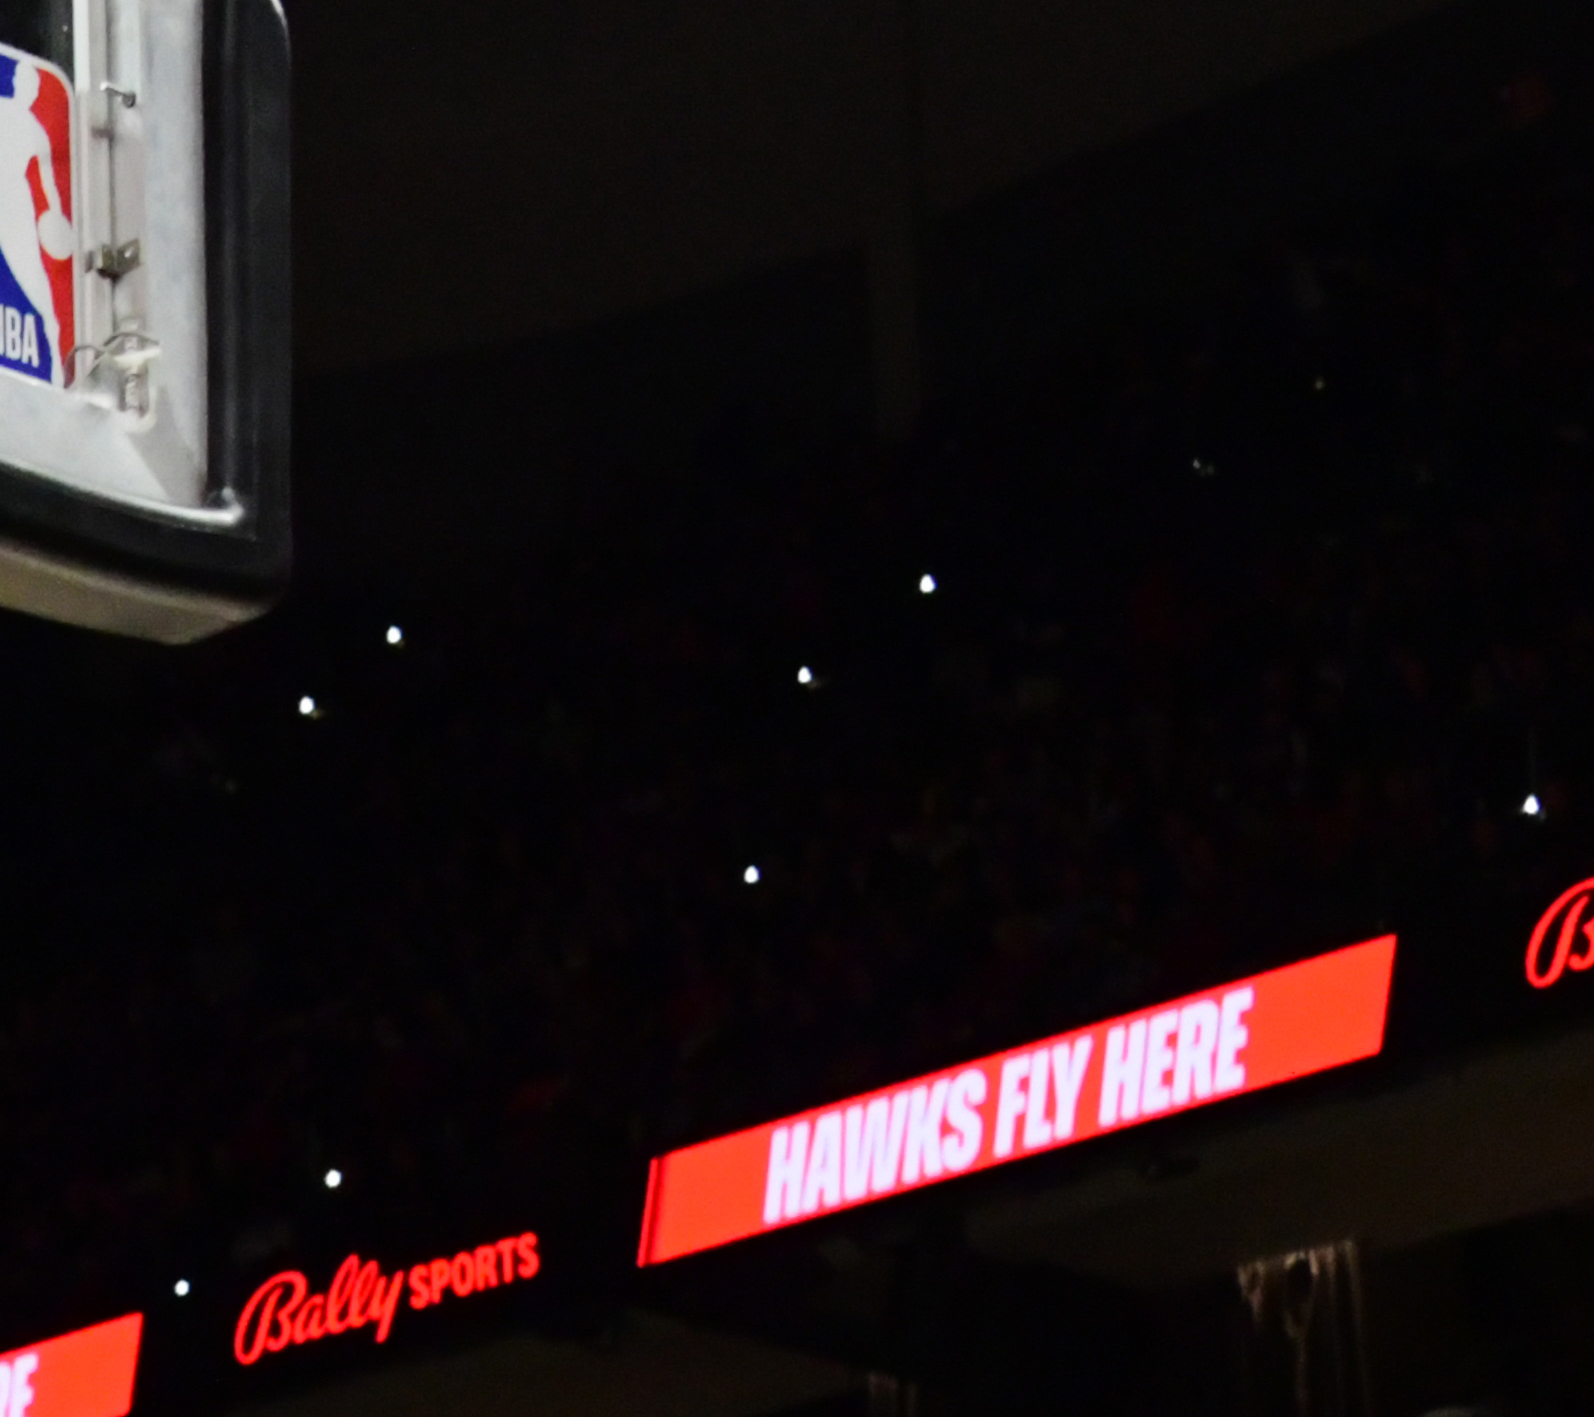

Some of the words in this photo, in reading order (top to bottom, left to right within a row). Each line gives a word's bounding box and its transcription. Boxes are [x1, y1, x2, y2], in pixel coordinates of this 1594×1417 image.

[762, 1068, 987, 1226] HAWKS
[992, 1036, 1093, 1160] FLY
[1097, 985, 1256, 1127] HERE
[233, 1254, 404, 1365] Bally
[408, 1232, 540, 1310] SPORTS
